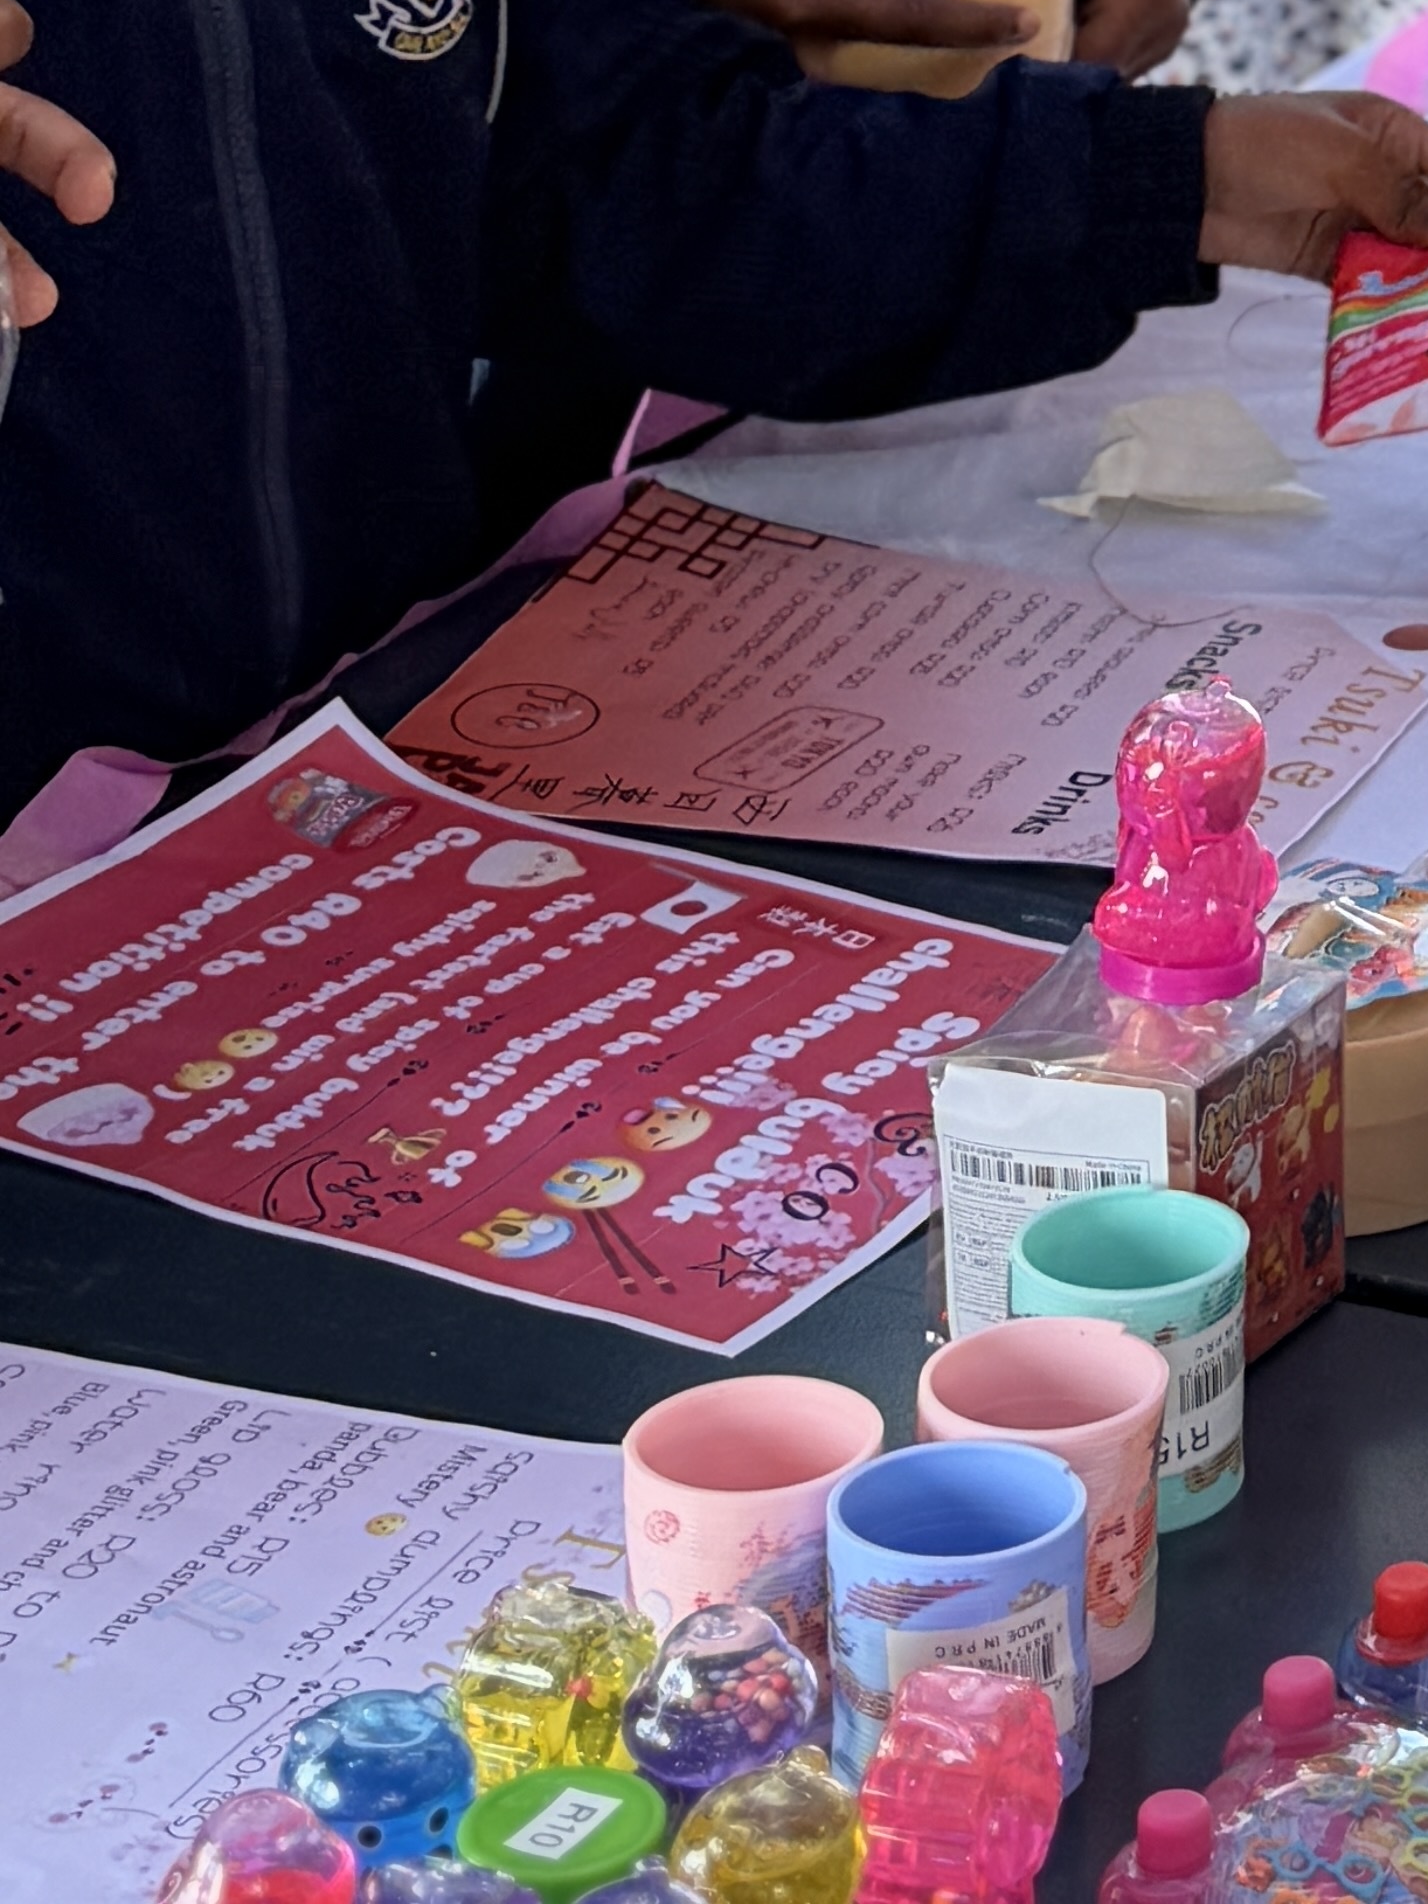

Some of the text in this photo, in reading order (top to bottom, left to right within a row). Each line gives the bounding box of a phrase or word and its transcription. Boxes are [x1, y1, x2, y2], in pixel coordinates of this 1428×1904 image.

[1165, 621, 1262, 690] Snacks
[1300, 666, 1425, 752] Tsuki
[1011, 771, 1113, 834] Drinks
[352, 827, 481, 890] Costs
[60, 854, 313, 992] competition
[261, 893, 361, 946] R40
[392, 900, 496, 956] sqishy
[529, 893, 595, 922] the
[201, 951, 266, 975] to
[410, 927, 535, 990] fastest
[82, 981, 197, 1050] enter
[262, 958, 395, 1028] surprise
[233, 913, 645, 1151] Eat a cup of spicy bulduk
[430, 932, 739, 1116] this challenge!!??
[682, 939, 953, 1107] challenge!!!
[272, 1035, 335, 1071] win
[427, 949, 794, 1187] Can you be winner of
[244, 1077, 275, 1091] a
[165, 1098, 250, 1143] free
[653, 1012, 980, 1223] Spicy bulduk
[42, 1382, 109, 1417] Blue,
[70, 1389, 165, 1454] Water
[168, 1400, 248, 1445] Green,
[126, 1449, 179, 1485] pink
[396, 1445, 487, 1508] Mistery
[66, 1485, 134, 1537] glitter
[90, 1422, 372, 1645] panda, bear and astronaut
[21, 1539, 69, 1569] and
[62, 1535, 136, 1579] R20
[226, 1537, 290, 1576] R15
[453, 1520, 541, 1584] Price
[13, 1591, 60, 1618] to
[1006, 1616, 1047, 1637] MADE
[983, 1635, 1001, 1646] IN
[208, 1673, 285, 1722] R60
[528, 1802, 599, 1849] R10
